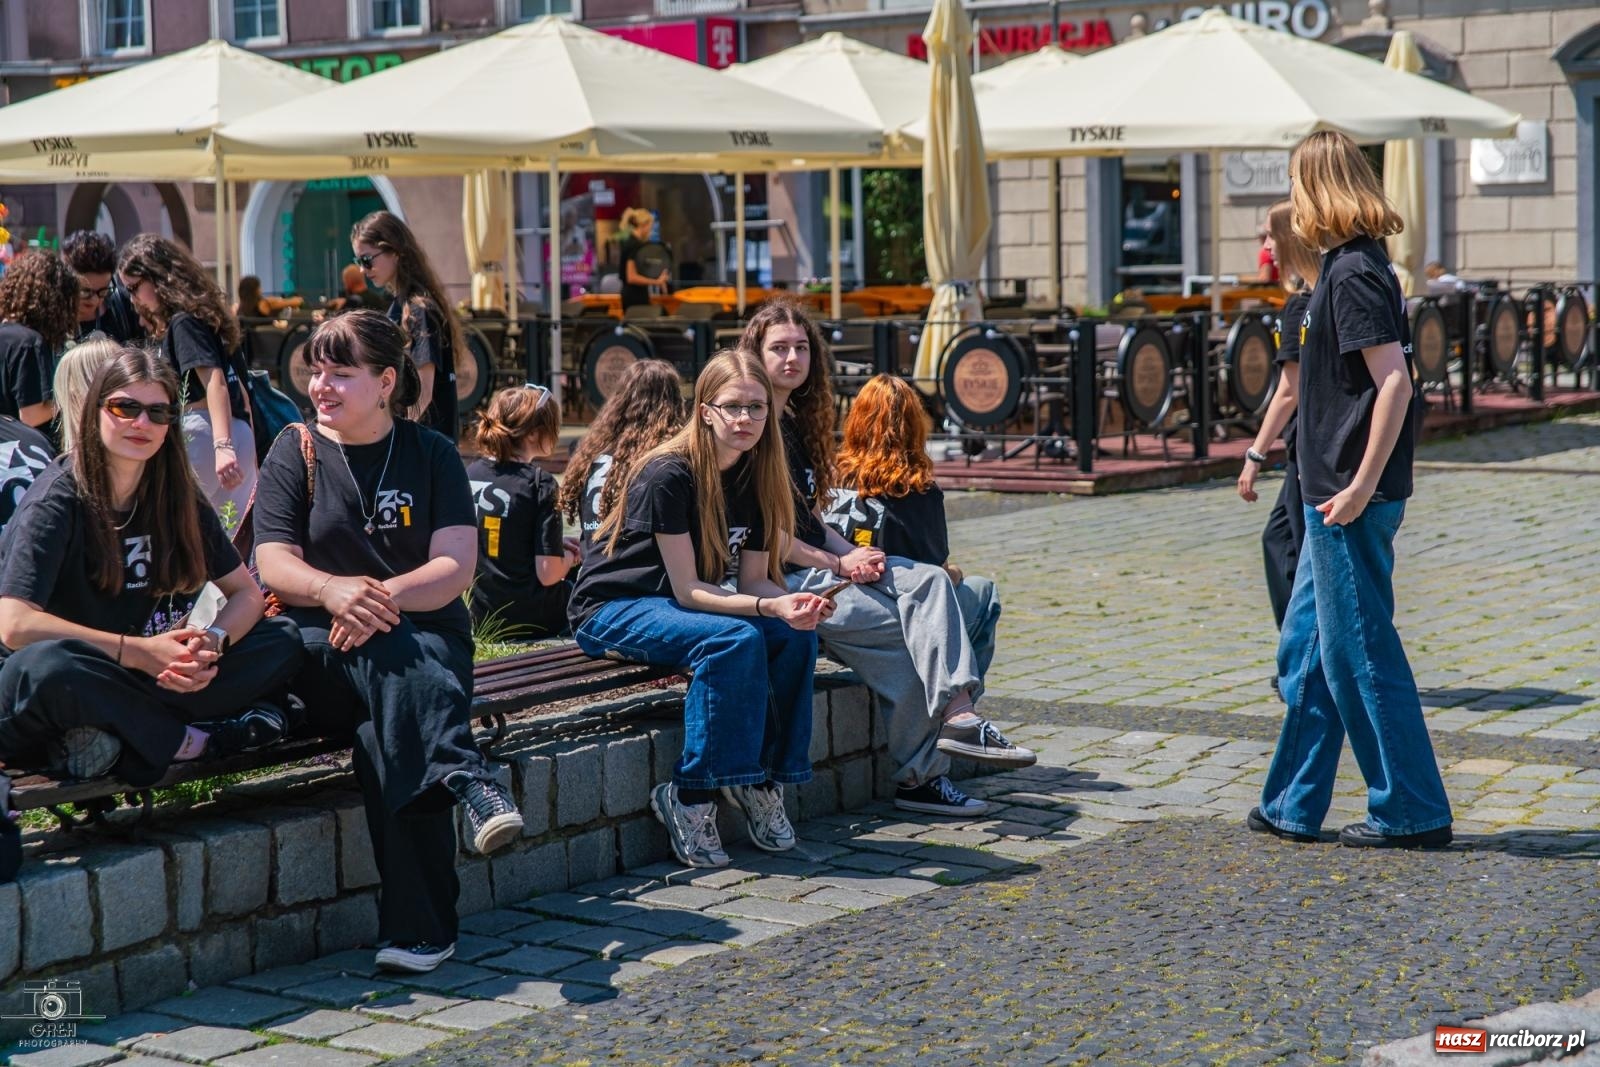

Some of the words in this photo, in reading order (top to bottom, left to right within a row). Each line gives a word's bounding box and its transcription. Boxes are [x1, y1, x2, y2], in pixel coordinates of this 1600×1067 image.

[364, 132, 418, 149] TYSKIE
[730, 131, 773, 146] TYSKIE
[1069, 125, 1126, 142] TYSKIE
[31, 136, 78, 153] TYSKIE
